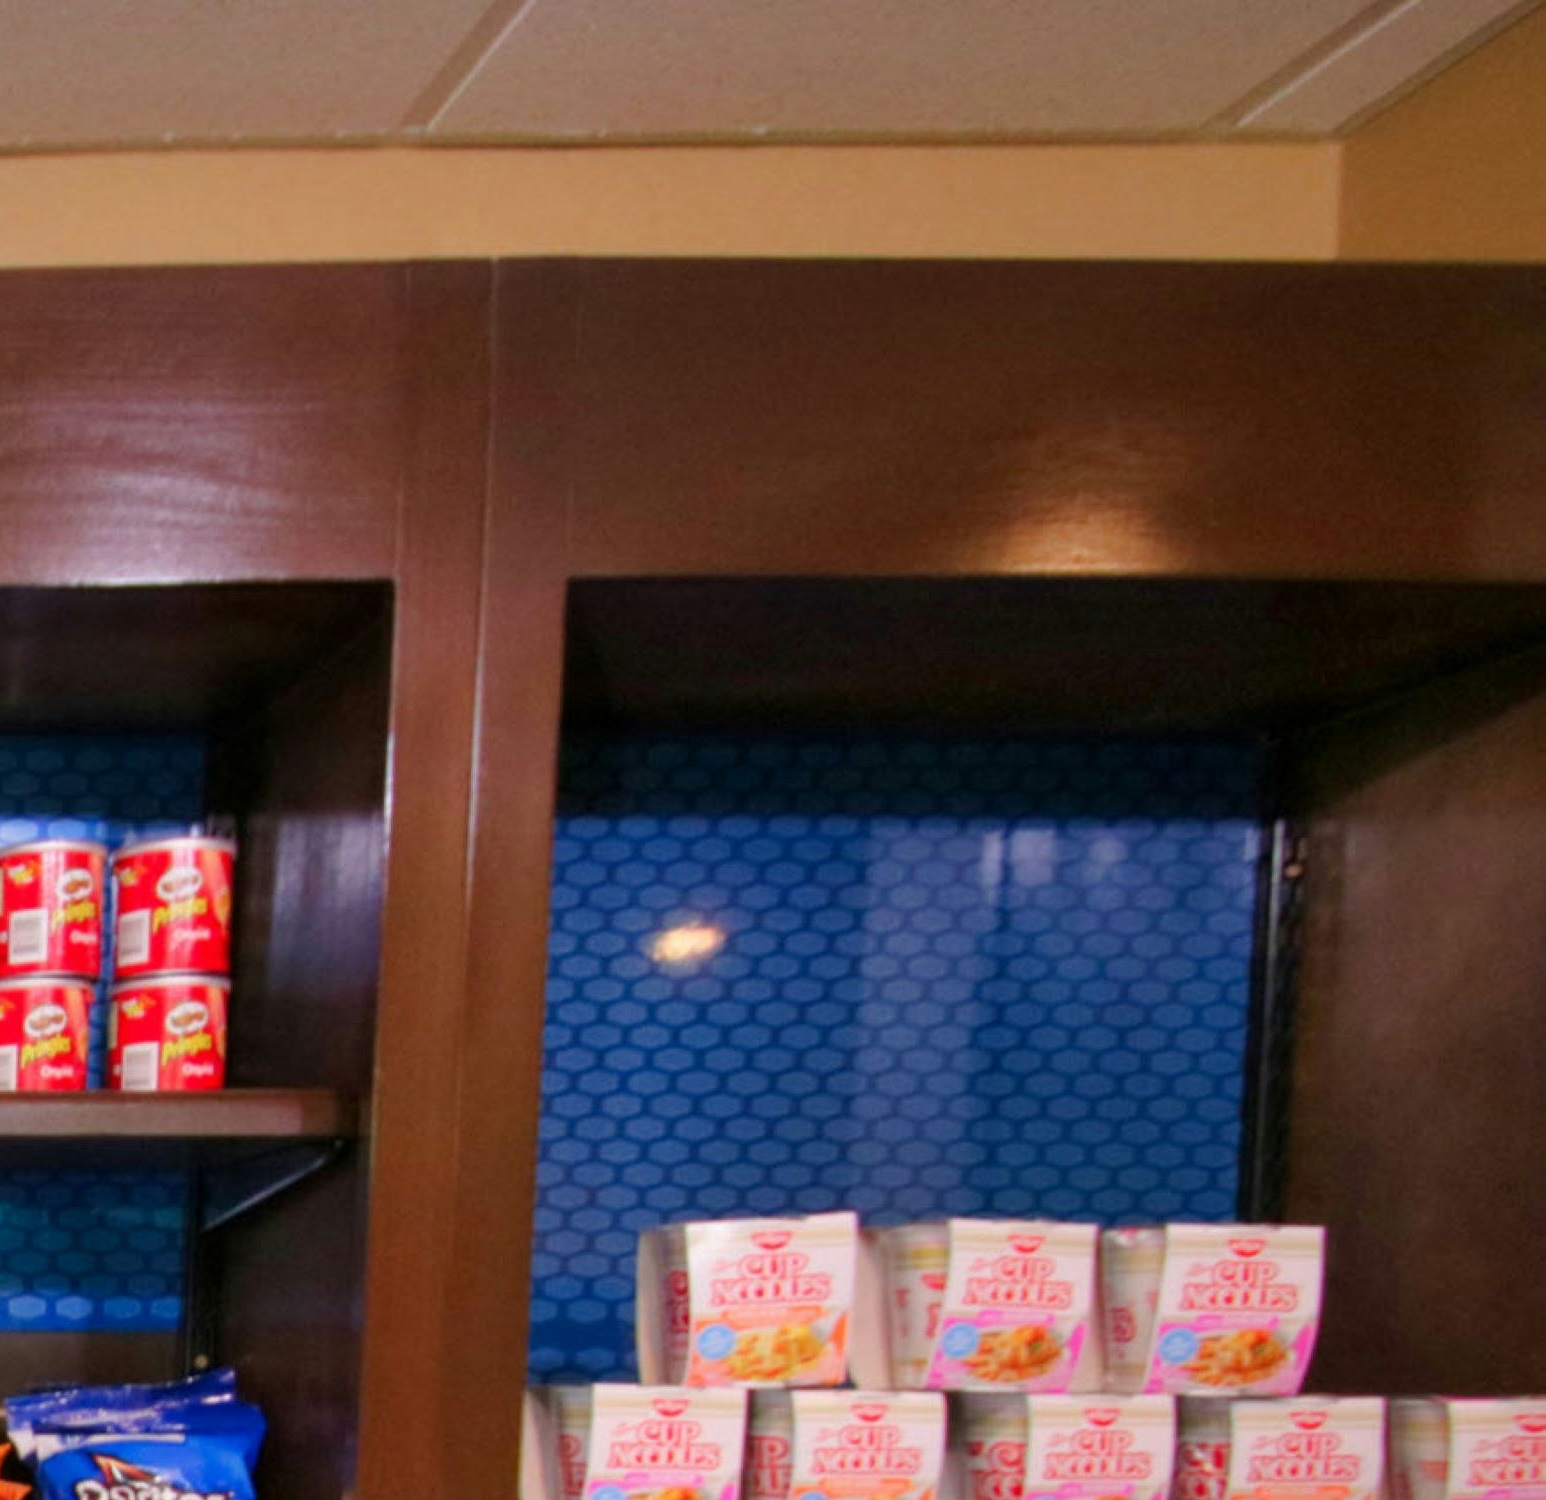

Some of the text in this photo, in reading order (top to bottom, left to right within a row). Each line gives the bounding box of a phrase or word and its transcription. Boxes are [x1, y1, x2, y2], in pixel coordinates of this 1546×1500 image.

[738, 1253, 810, 1278] CUP
[992, 1256, 1056, 1281] CUP
[1212, 1260, 1280, 1284] CUP
[711, 1273, 831, 1306] NOODLES
[963, 1278, 1073, 1308] NOODLES
[1179, 1282, 1298, 1312] NOODLES
[636, 1421, 702, 1446] CUP
[836, 1425, 900, 1449] CUP
[1071, 1430, 1134, 1452] CUP
[1277, 1432, 1340, 1456] CUP
[609, 1442, 720, 1470] NOODLES
[1501, 1436, 1546, 1459] CU
[812, 1447, 921, 1474] NOODLES
[1043, 1452, 1151, 1479] NOODLES
[1247, 1455, 1361, 1482] NOODLES
[1468, 1460, 1546, 1486] NOOD
